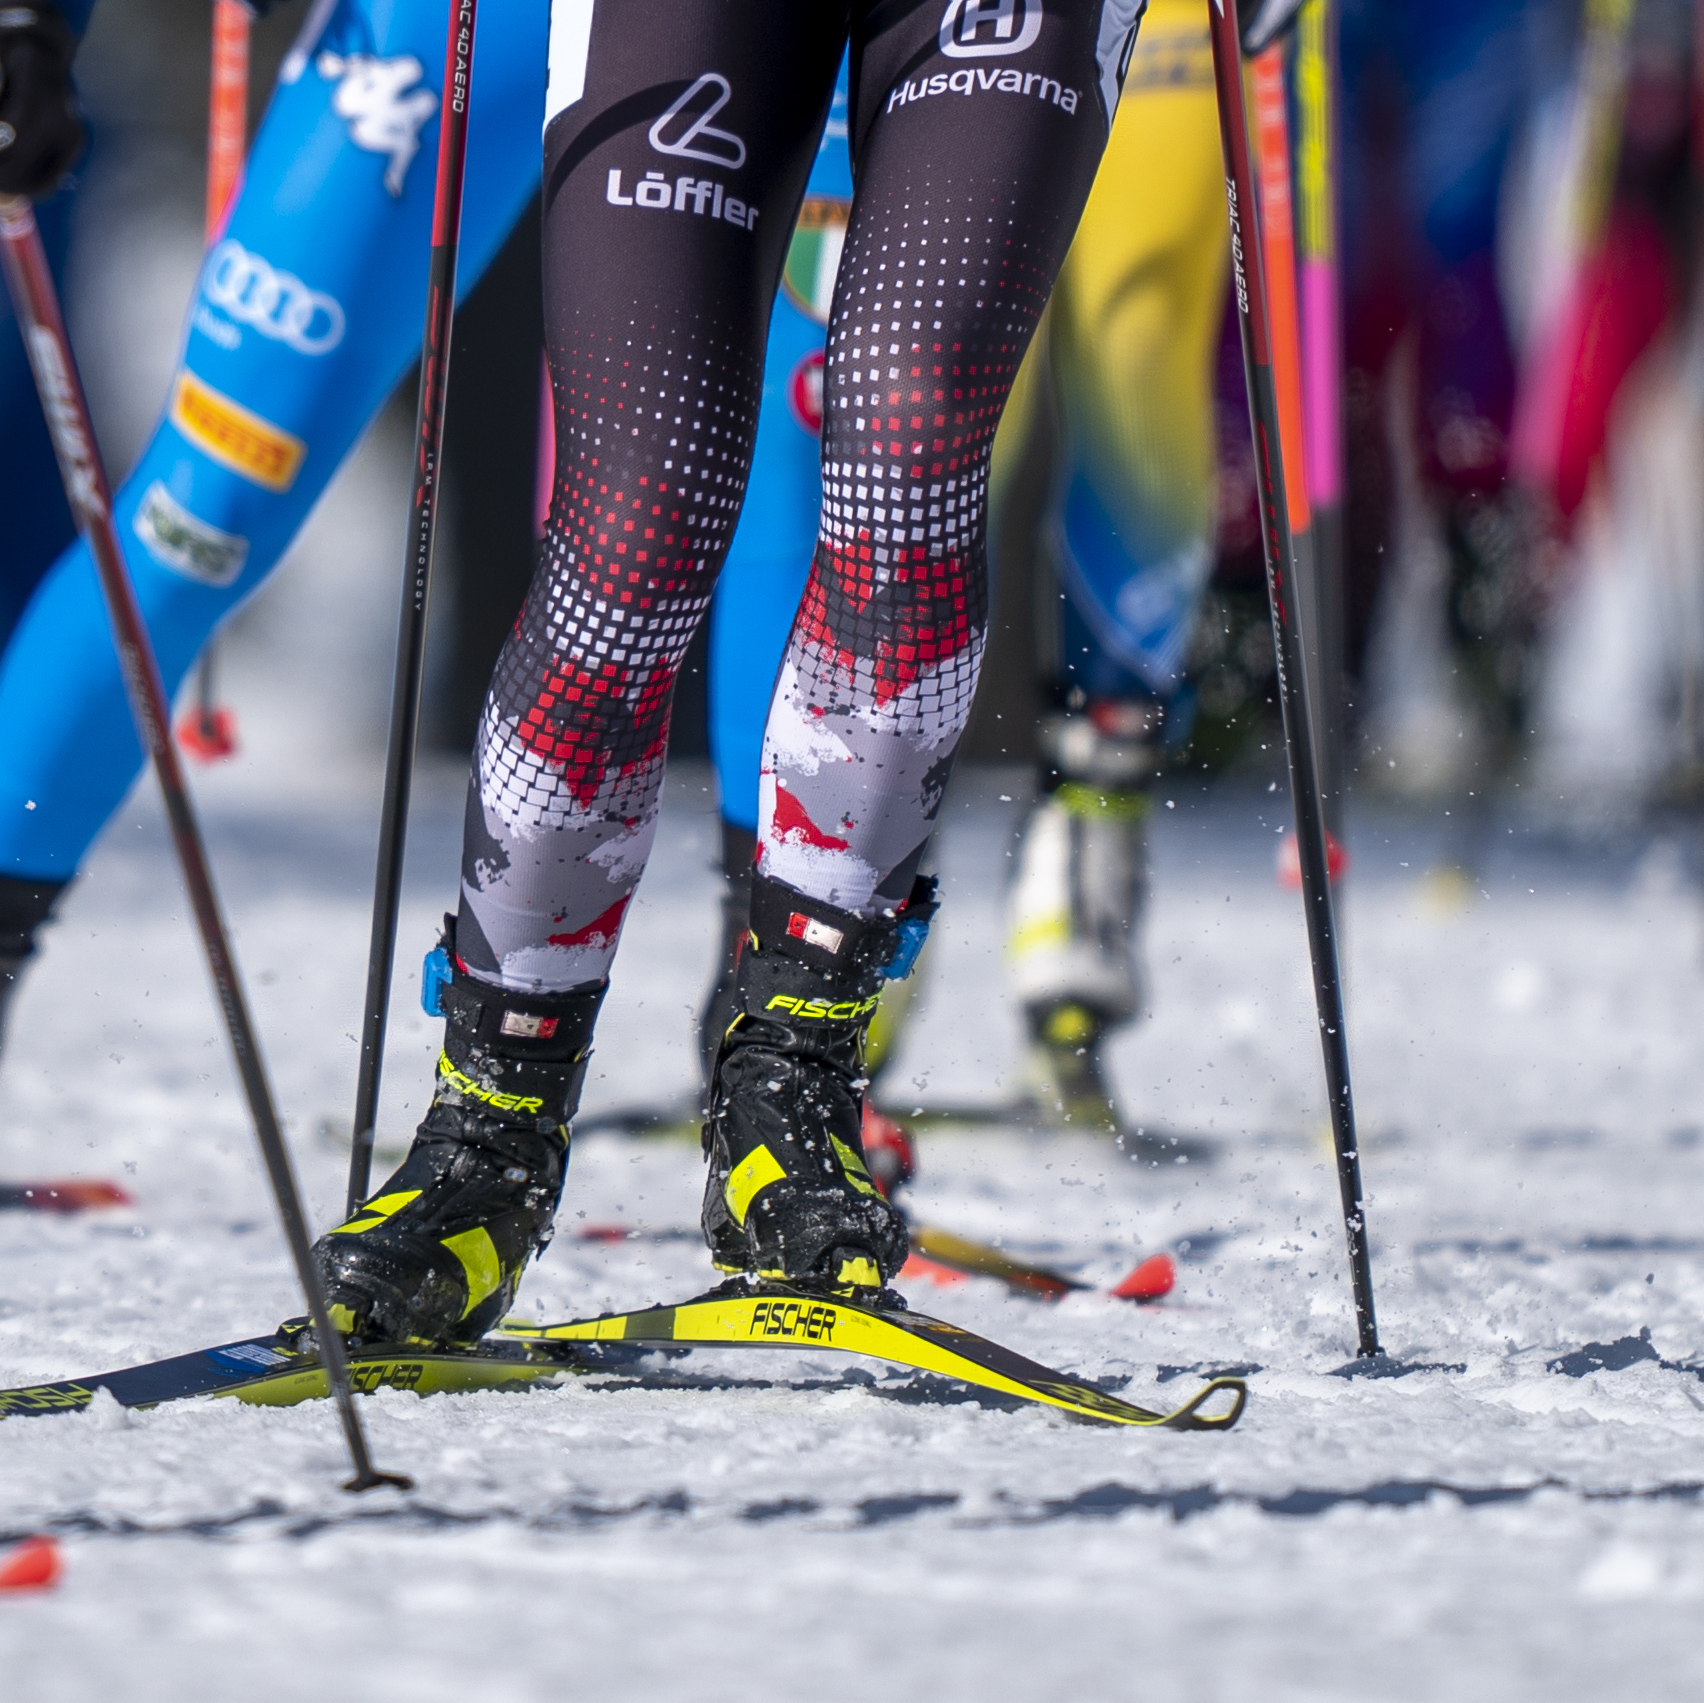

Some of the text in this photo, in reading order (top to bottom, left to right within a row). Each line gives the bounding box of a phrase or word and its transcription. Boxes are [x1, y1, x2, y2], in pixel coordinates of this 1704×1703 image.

[456, 27, 470, 56] 4.0
[452, 54, 467, 114] AERO
[886, 68, 1078, 115] Husqvarna
[1225, 176, 1241, 235] TRIAC
[1235, 260, 1249, 314] AERO
[414, 498, 431, 611] TECHNOLOGY
[1272, 601, 1289, 704] TECHNOLOGY
[766, 988, 885, 1020] FISCHE
[439, 1046, 544, 1114] ISCHER
[749, 1301, 837, 1342] FISCHER
[341, 1363, 423, 1395] ISCHER
